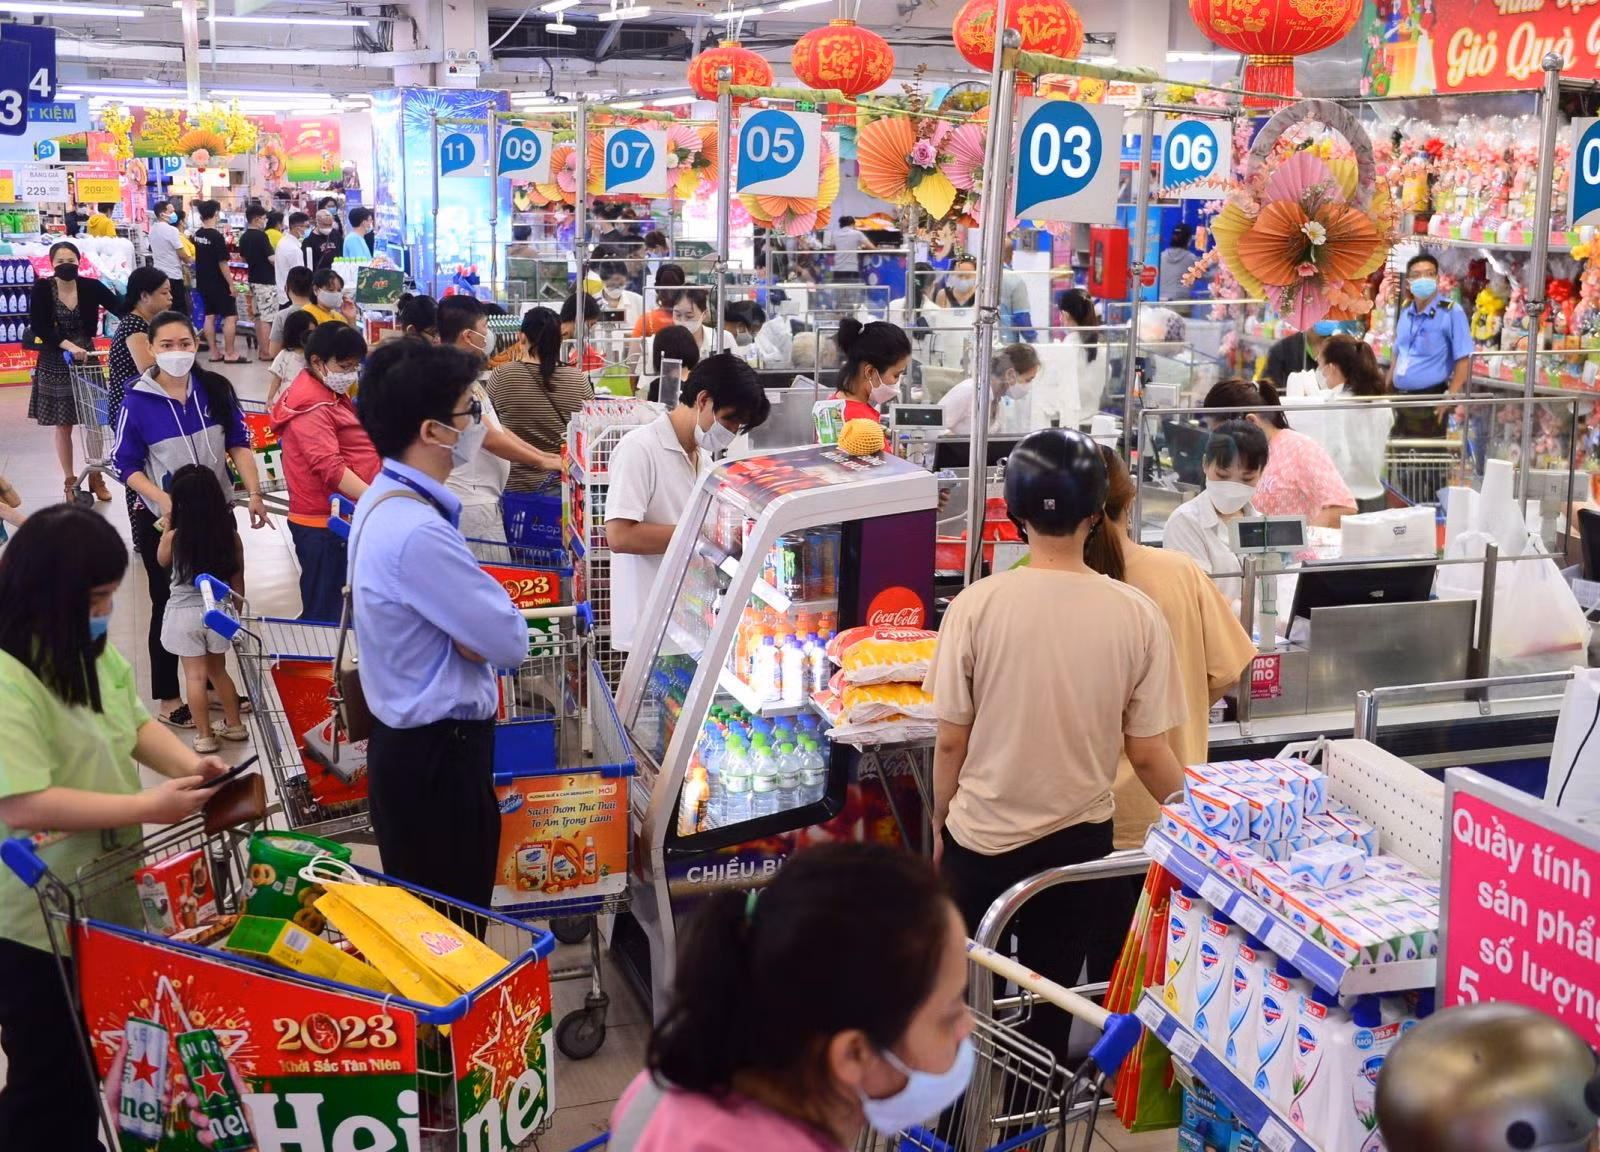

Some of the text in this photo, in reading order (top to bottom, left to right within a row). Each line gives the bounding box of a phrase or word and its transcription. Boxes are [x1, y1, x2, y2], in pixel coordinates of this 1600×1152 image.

[1447, 26, 1498, 87] Giỏ
[1506, 21, 1577, 81] Quà
[29, 68, 51, 97] 4
[0, 90, 23, 126] 3
[40, 105, 73, 121] KIỆM
[39, 145, 52, 155] 21
[444, 142, 465, 161] 11
[505, 136, 537, 161] 09
[611, 141, 651, 169] 07
[746, 126, 796, 164] 05
[1030, 122, 1092, 179] 03
[1169, 134, 1213, 170] 06
[166, 157, 180, 167] 19
[686, 856, 755, 883] CHIỀU
[1453, 808, 1591, 899] Quầy tính
[1477, 879, 1528, 927] sản
[1479, 935, 1516, 975] số
[272, 1012, 397, 1054] 2023
[341, 1059, 367, 1072] Tân
[368, 1058, 401, 1071] Niên
